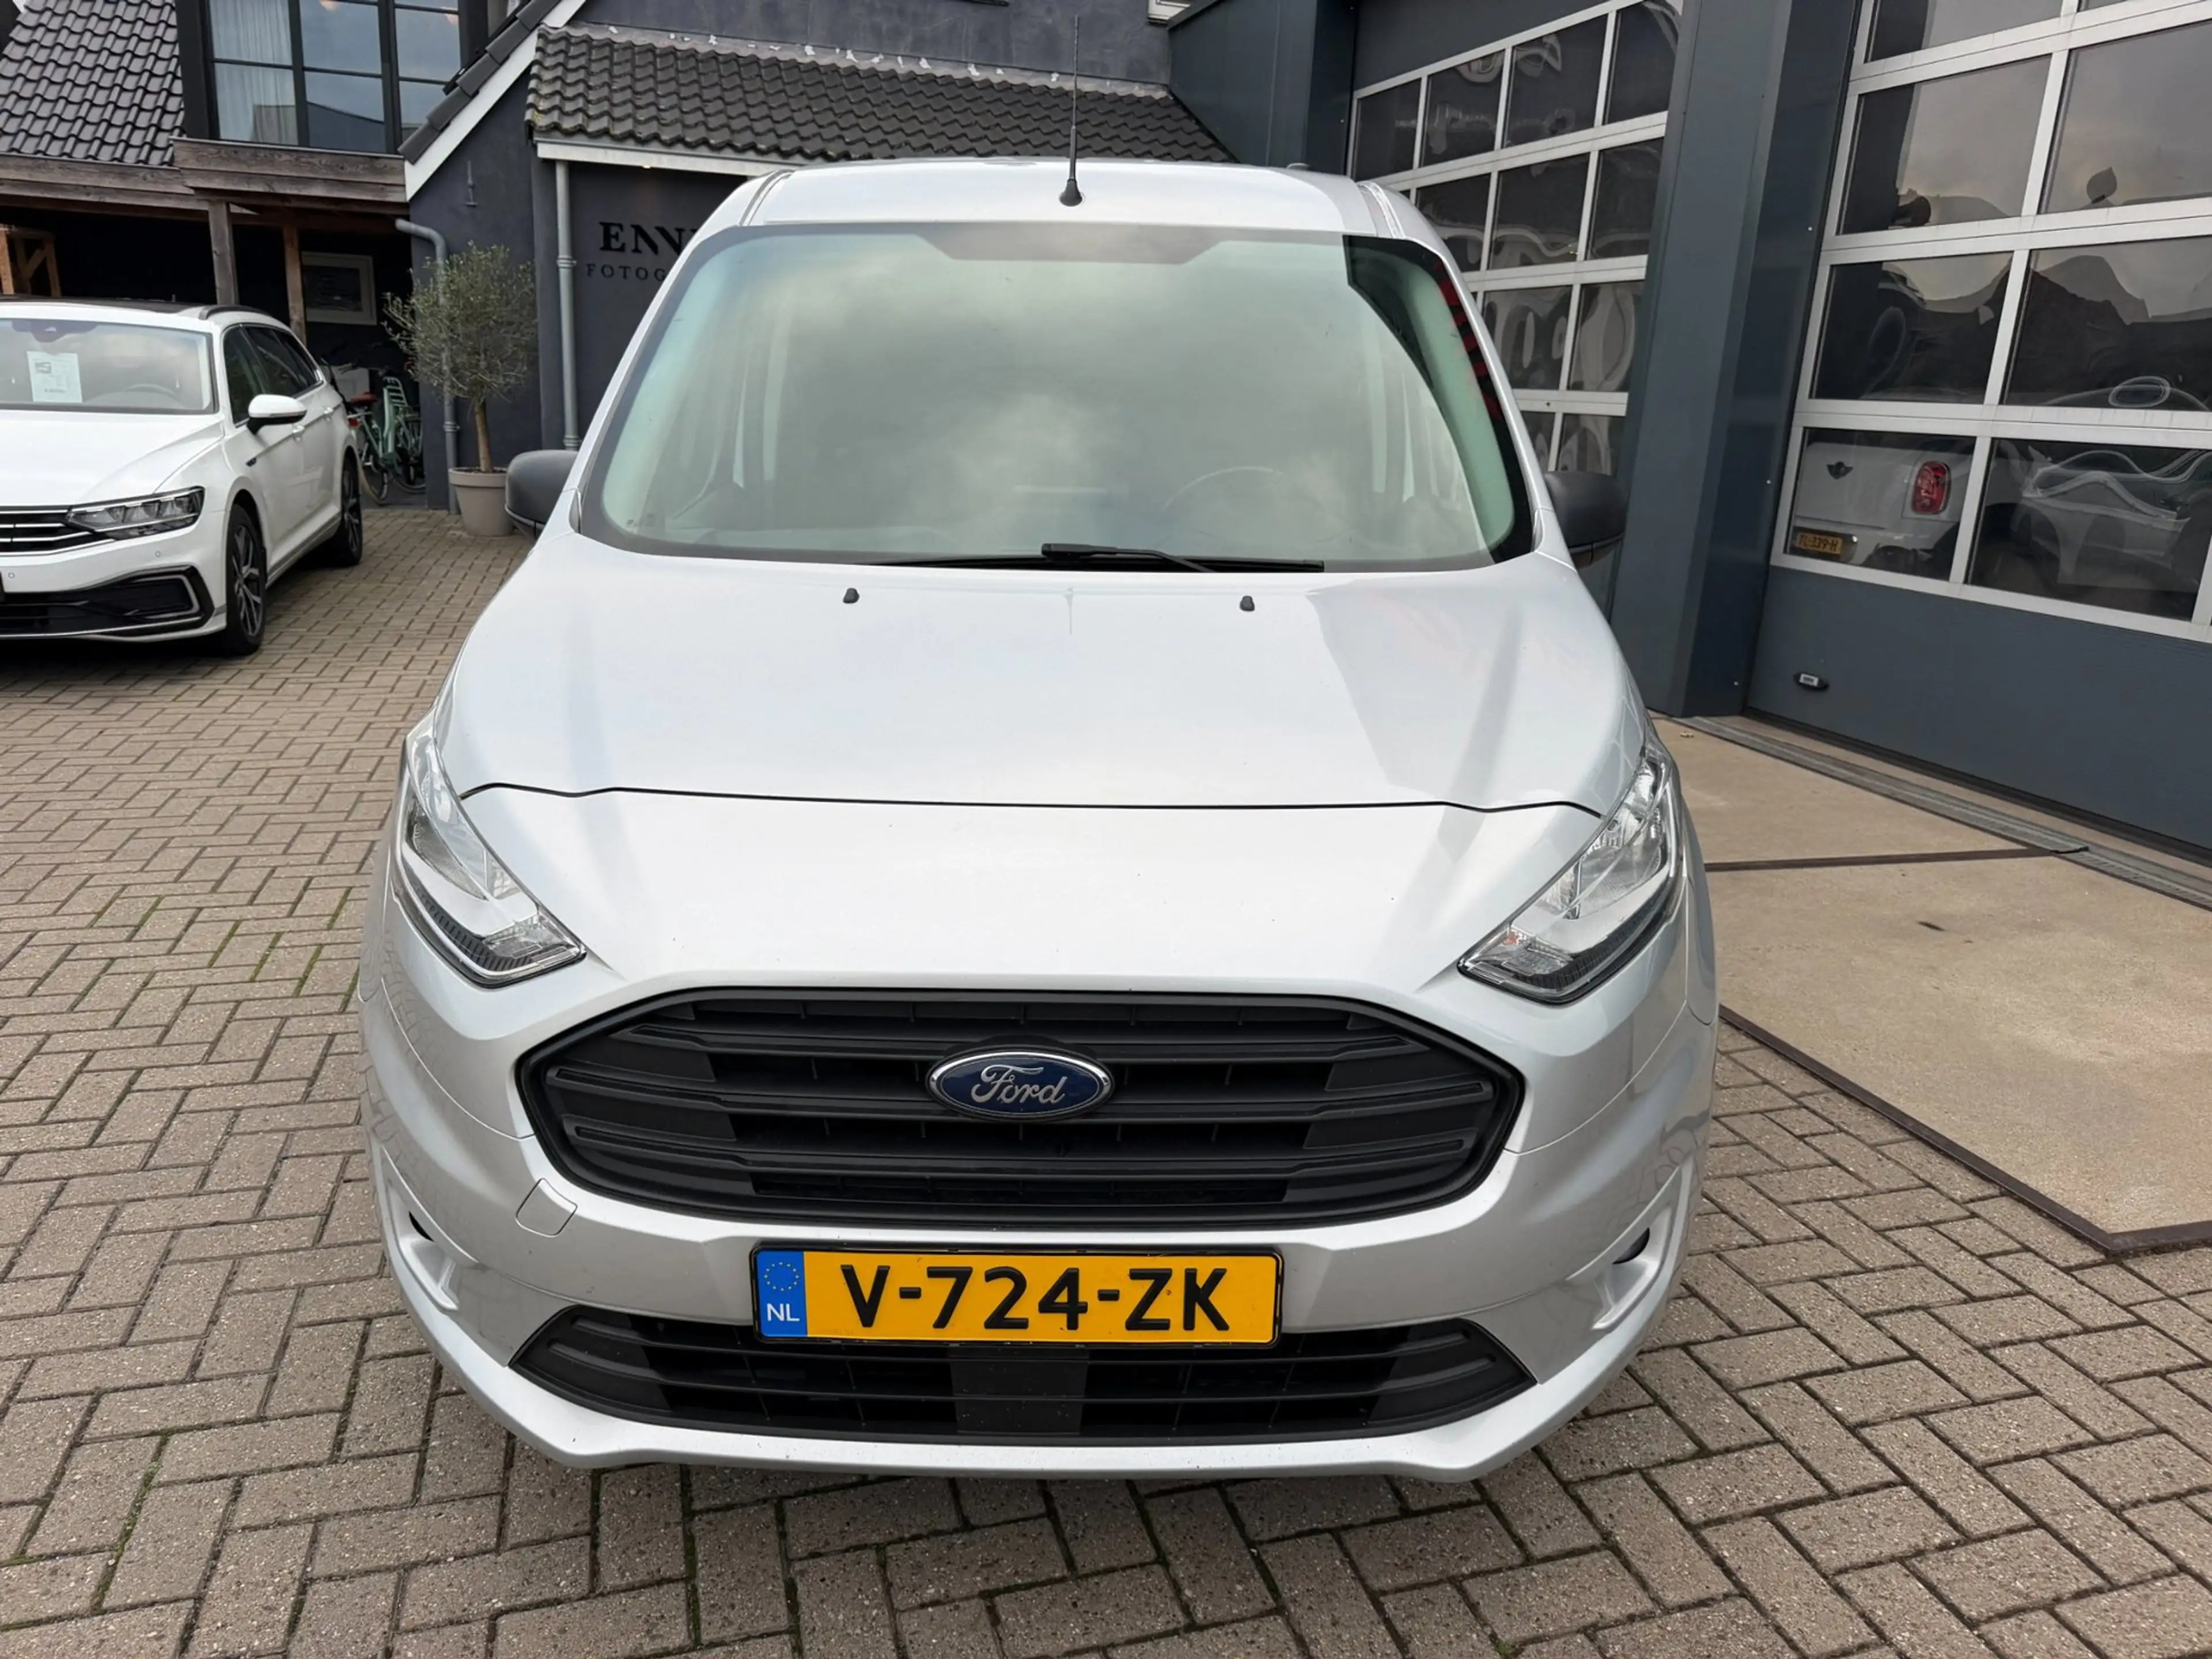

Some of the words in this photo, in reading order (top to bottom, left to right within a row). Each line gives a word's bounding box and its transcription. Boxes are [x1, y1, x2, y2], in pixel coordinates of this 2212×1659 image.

[971, 1065, 1067, 1104] Ford
[767, 1303, 800, 1321] NL
[840, 1264, 1230, 1332] V-724-ZK
